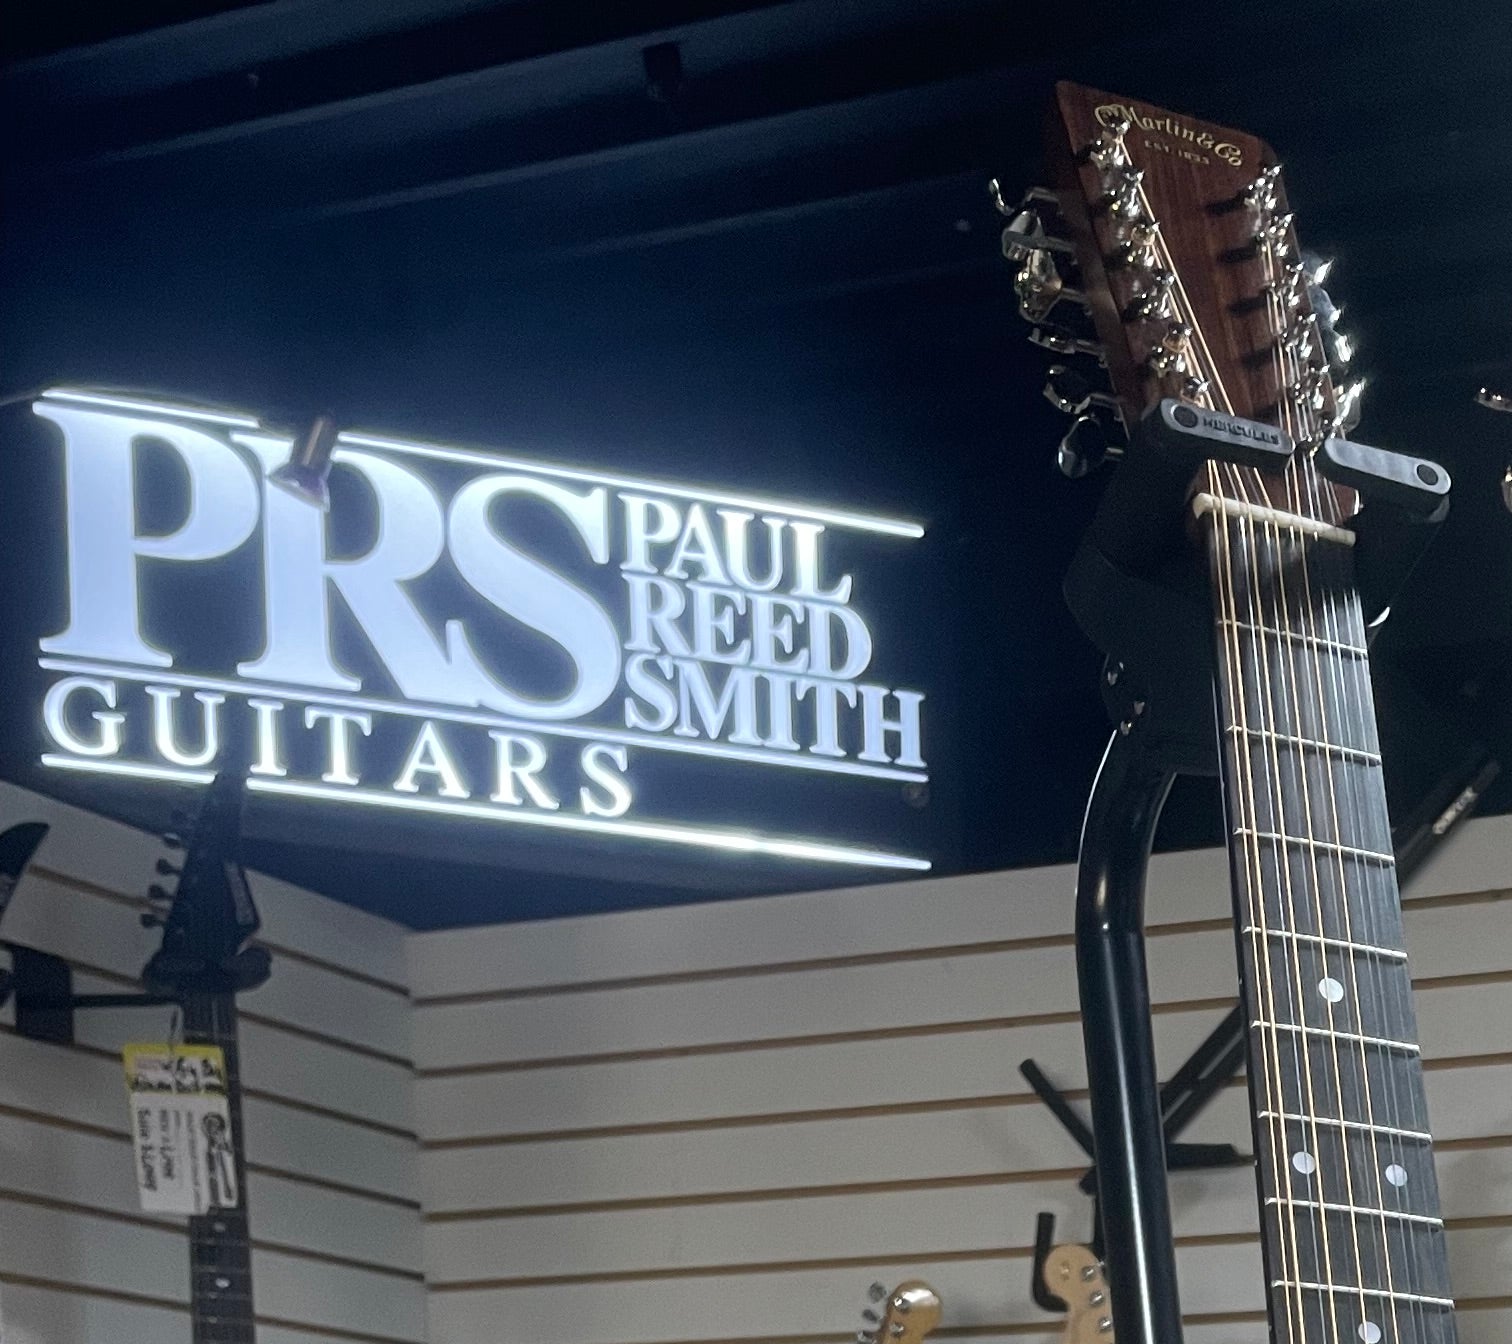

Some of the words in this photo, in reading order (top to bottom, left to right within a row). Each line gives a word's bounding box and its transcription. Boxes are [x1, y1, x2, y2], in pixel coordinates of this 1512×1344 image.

[32, 401, 623, 722] PRS
[618, 492, 853, 604] PAUL
[623, 573, 873, 683] REED
[41, 674, 635, 819] GUITARS
[624, 654, 928, 770] SMITH
